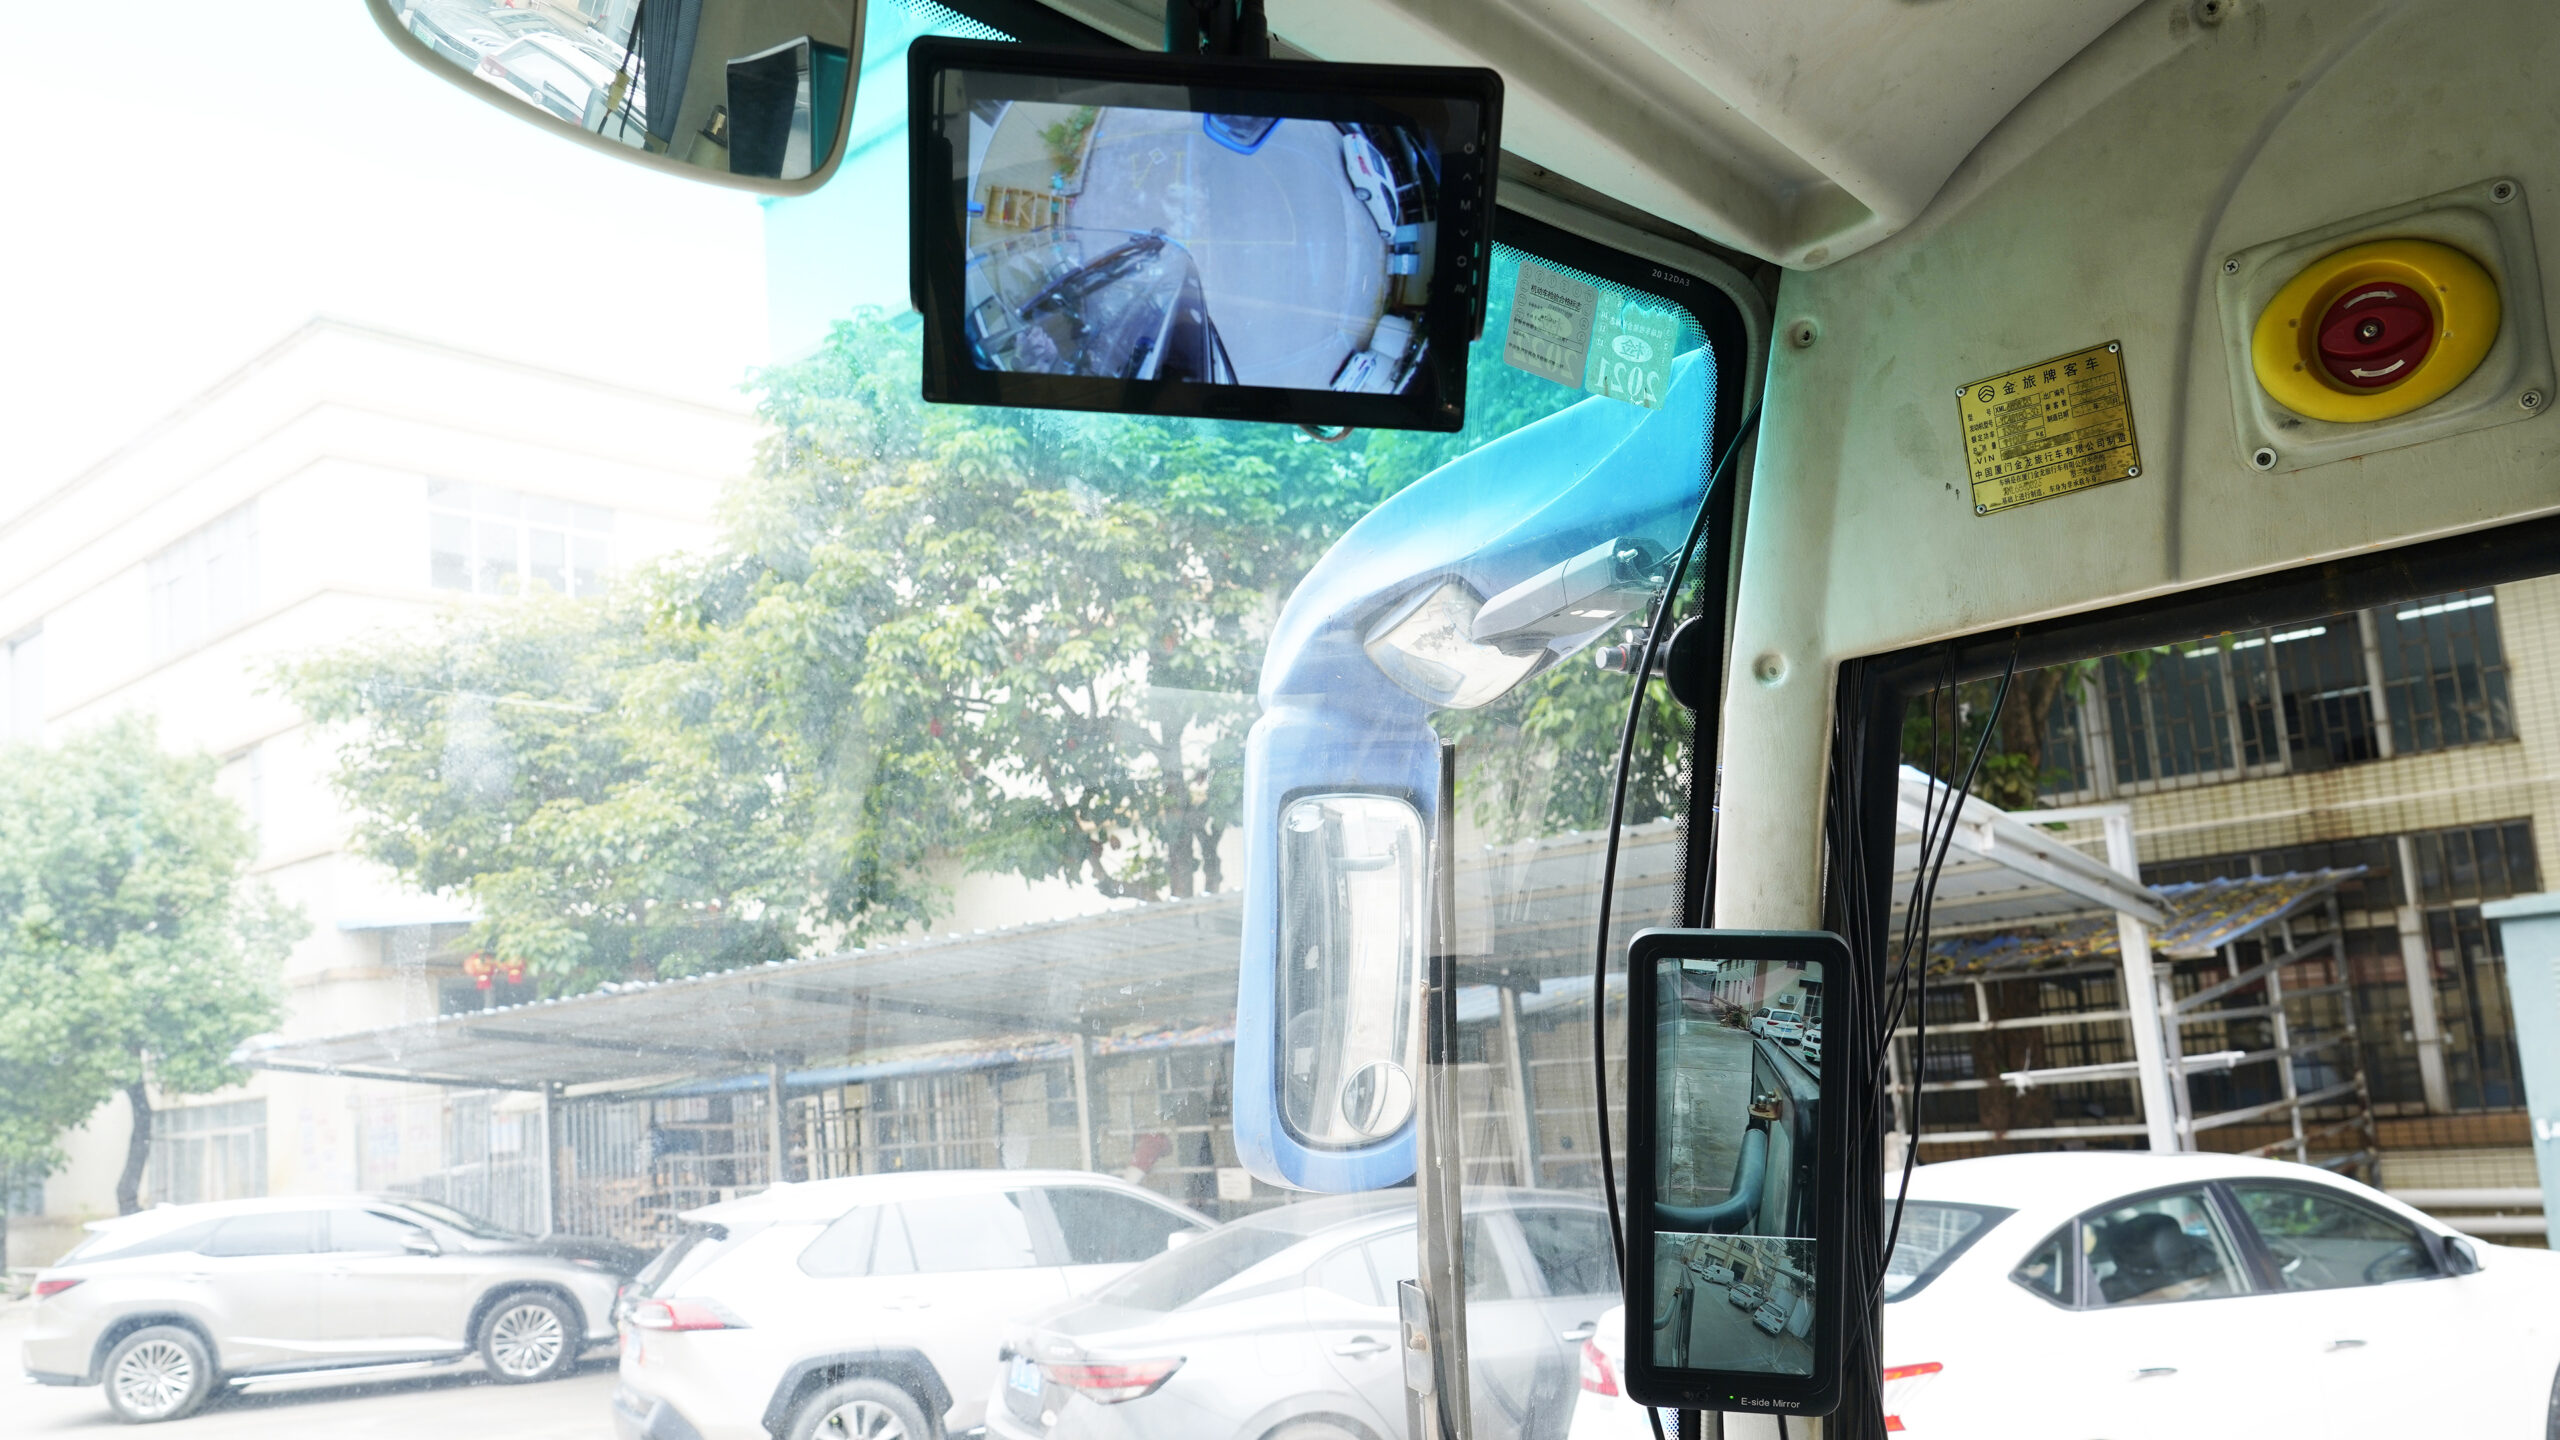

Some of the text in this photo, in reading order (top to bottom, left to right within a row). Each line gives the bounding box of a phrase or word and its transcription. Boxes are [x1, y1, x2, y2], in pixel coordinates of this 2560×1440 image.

[1460, 199, 1471, 211] M
[2001, 355, 2099, 395] 金旅牌客车
[2042, 386, 2065, 400] 出厂编号
[2046, 410, 2069, 423] 制造日期
[1974, 431, 2126, 480] 中国厦门金龙旅行车有限公司制造
[1976, 453, 1995, 465] VIN
[1741, 1397, 1801, 1409] E-side Mirror
